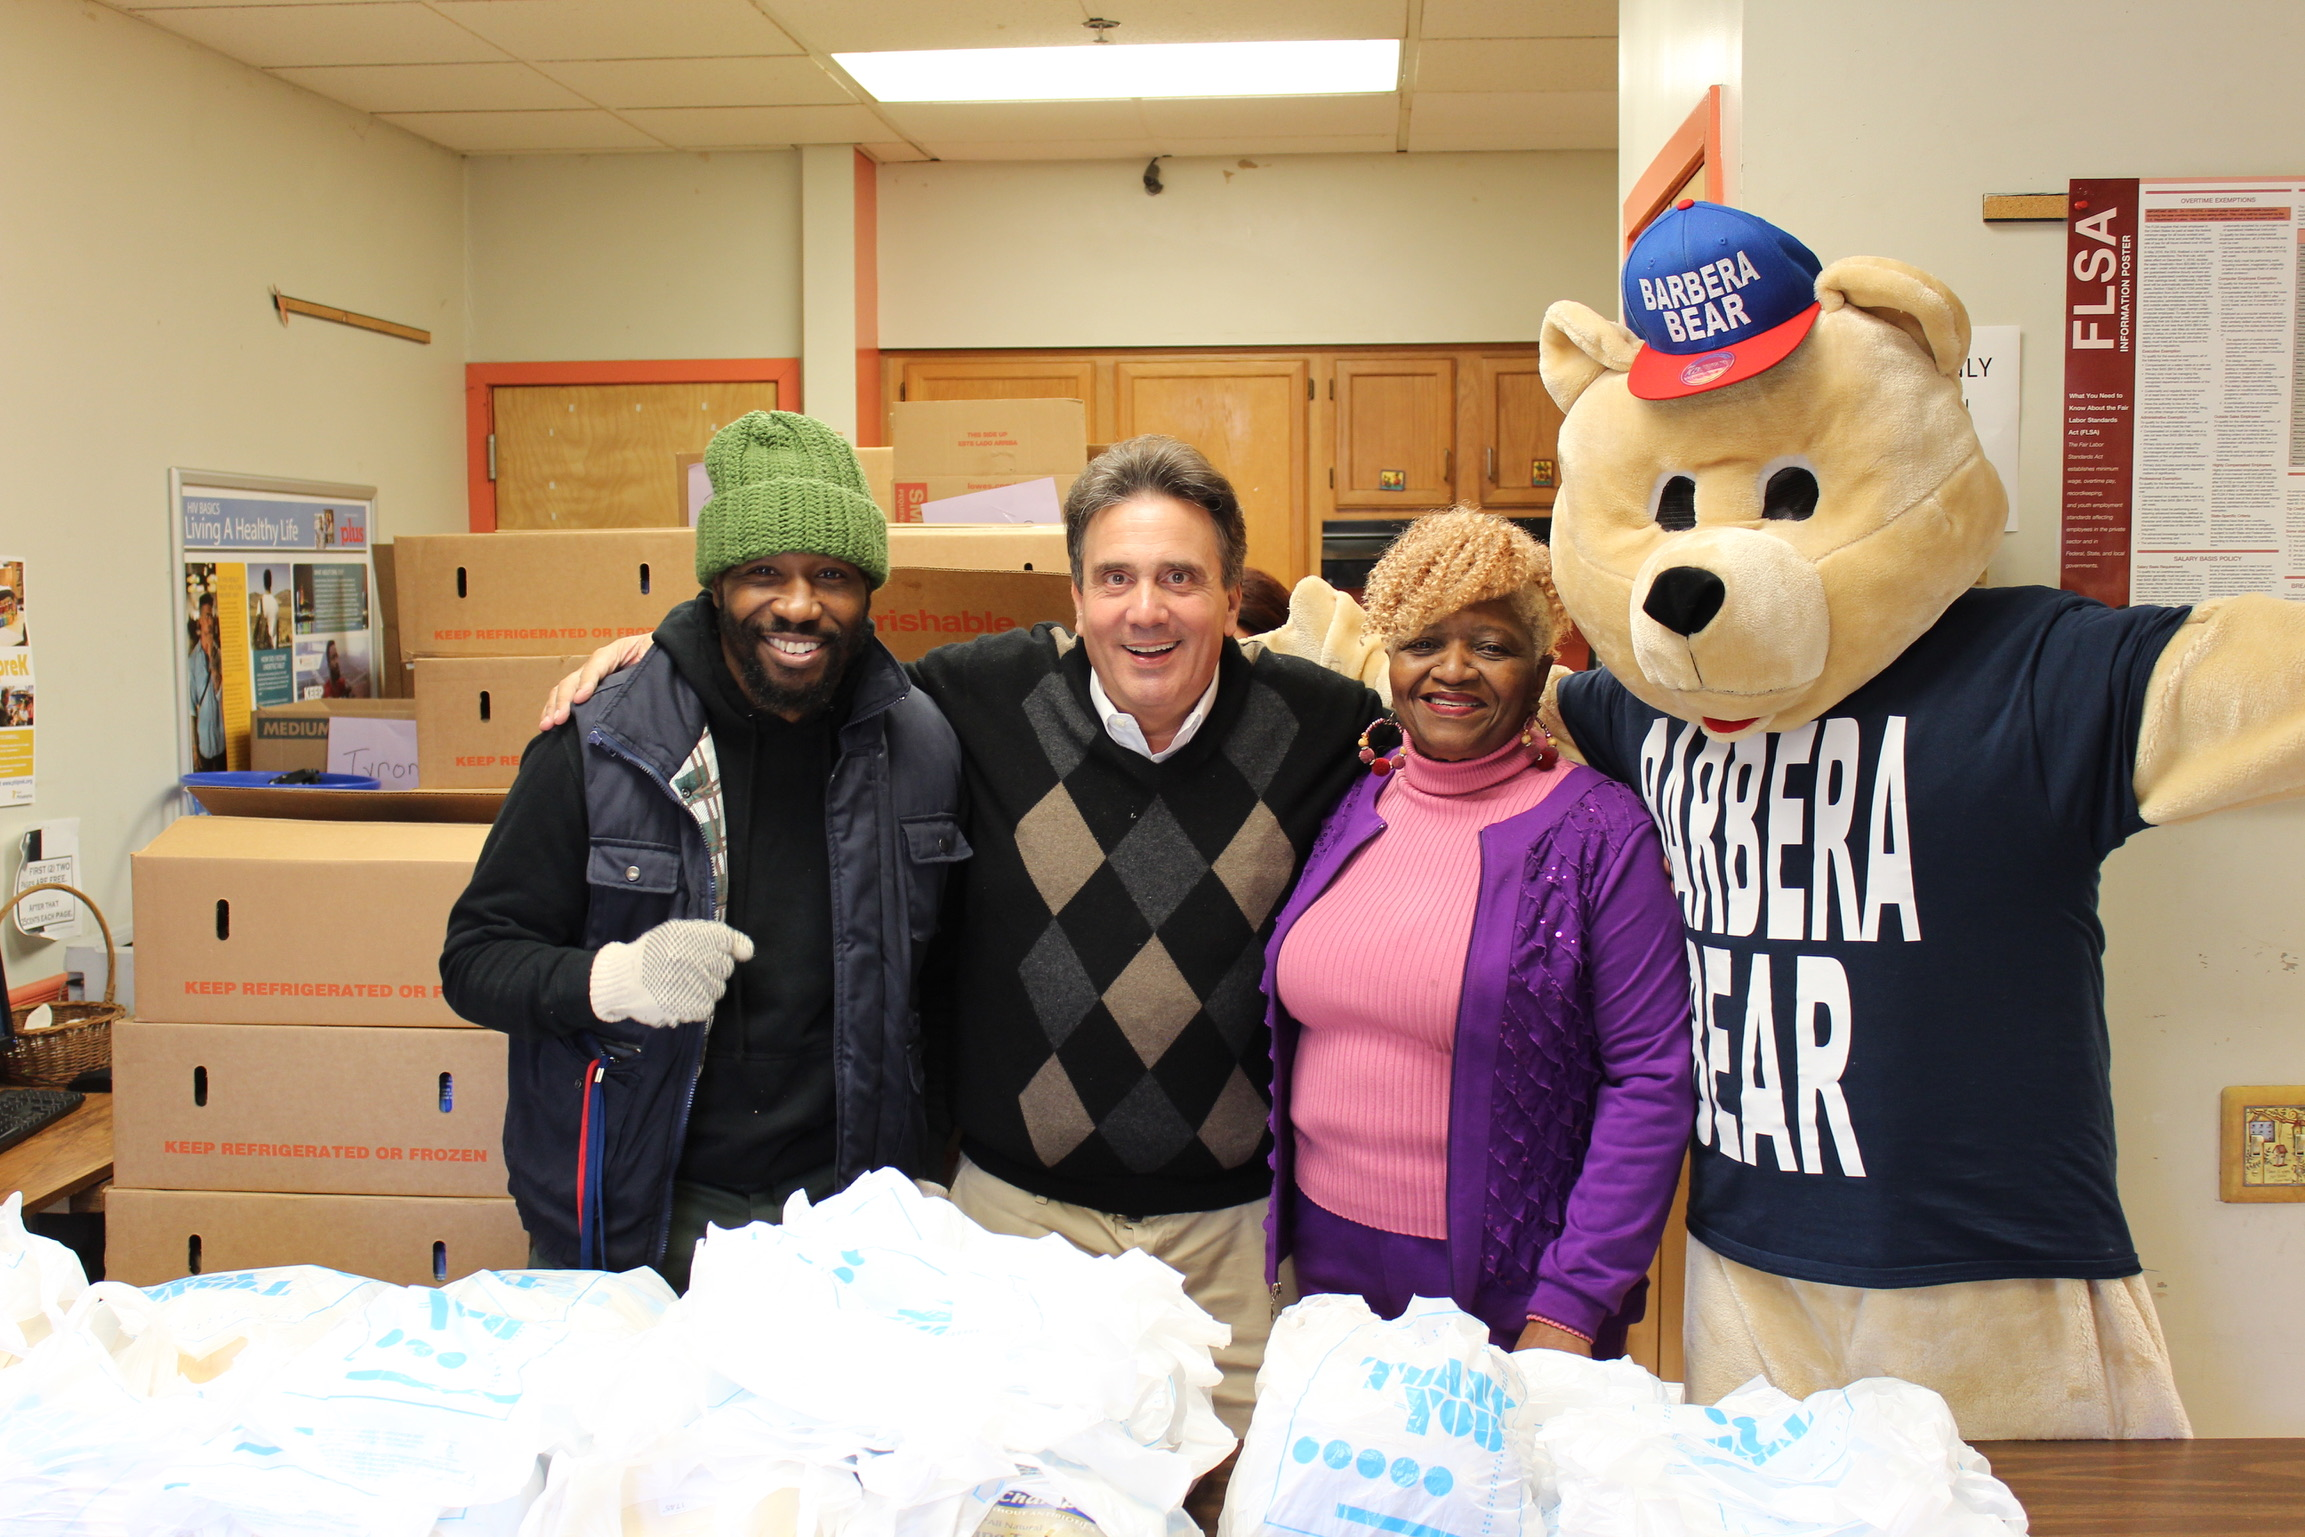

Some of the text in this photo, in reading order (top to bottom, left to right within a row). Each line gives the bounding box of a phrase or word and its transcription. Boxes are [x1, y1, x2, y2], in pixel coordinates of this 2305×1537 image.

[1638, 250, 1761, 311] BARBERA
[2072, 207, 2117, 349] FLSA
[2120, 235, 2131, 352] INFORMATION POSTER
[1663, 293, 1752, 343] BEAR
[187, 502, 220, 515] HIV BASICS
[185, 516, 299, 546] Living A Healthy Life
[340, 517, 364, 545] plus
[434, 629, 472, 641] KEEP
[476, 628, 587, 640] REFRIGERATED
[592, 628, 612, 638] OR
[304, 686, 324, 700] KEEP
[455, 756, 496, 767] KEEP
[29, 862, 71, 876] FIRST (2) TWO
[45, 900, 59, 909] THAT
[185, 981, 237, 996] KEEP
[242, 982, 394, 998] REFRIGERATED
[399, 985, 427, 998] OR
[164, 1141, 487, 1162] KEEP REFRIGERATED OR FROZEN
